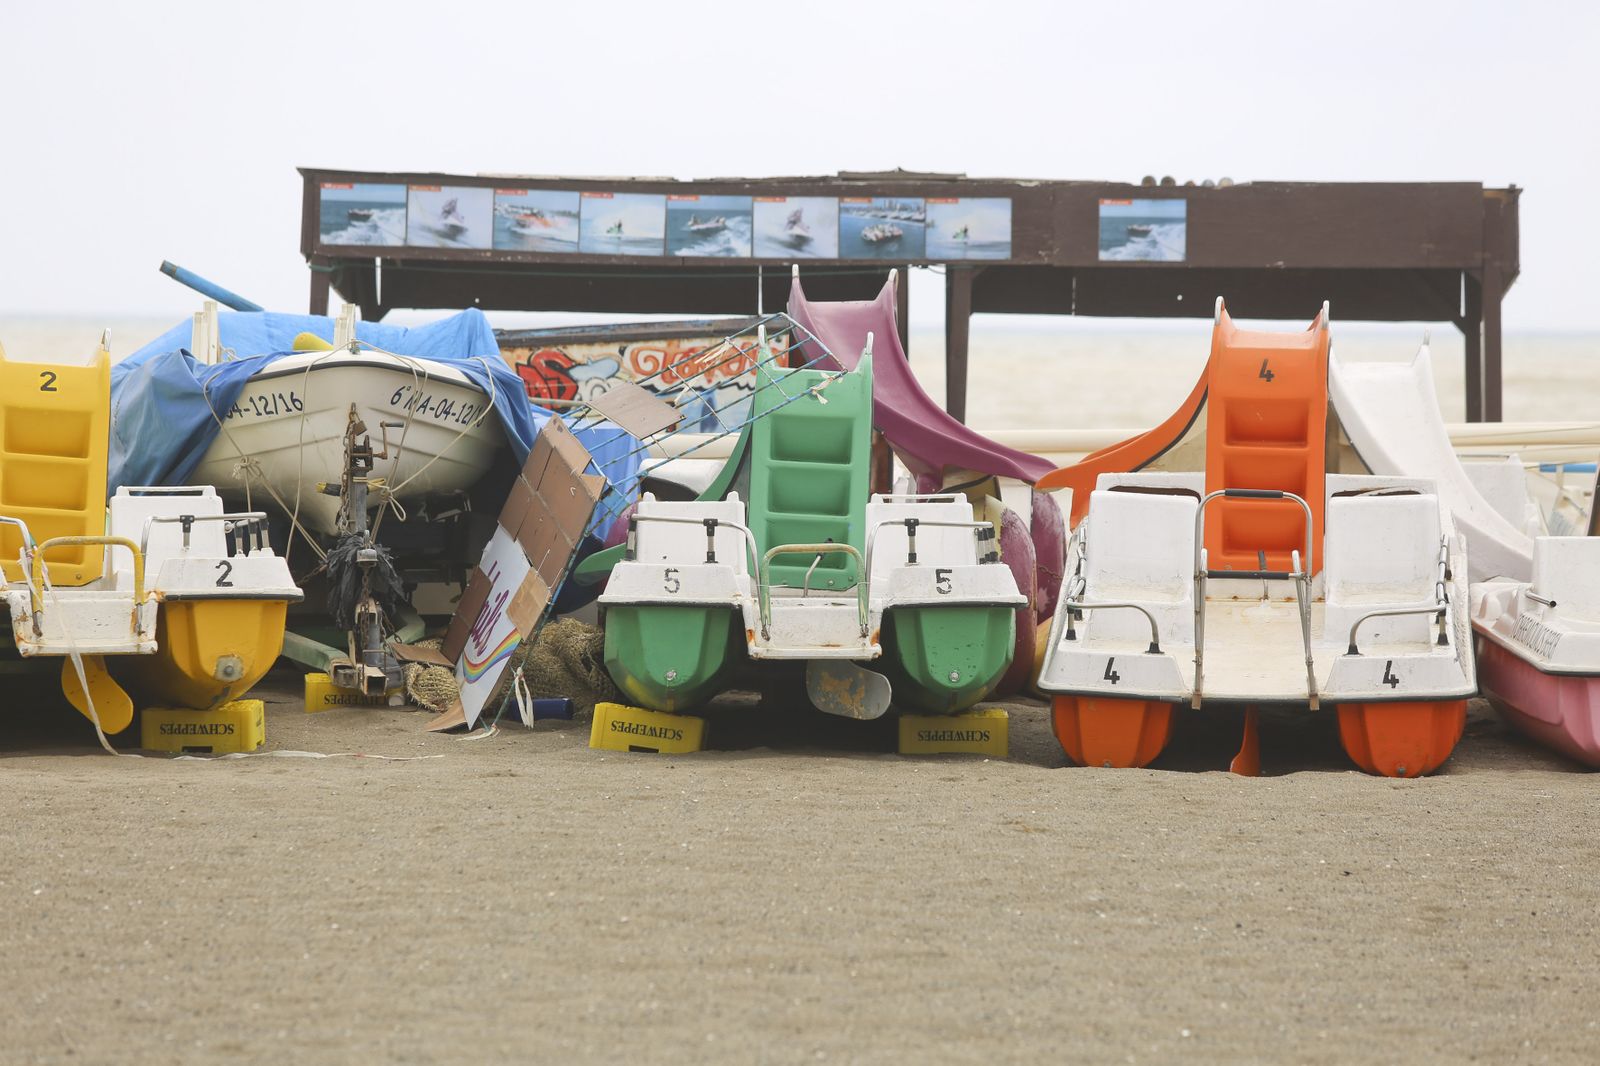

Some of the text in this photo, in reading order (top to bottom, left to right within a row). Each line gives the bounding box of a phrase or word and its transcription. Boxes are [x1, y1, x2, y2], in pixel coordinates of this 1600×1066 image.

[39, 371, 57, 392] 2
[1259, 359, 1275, 382] 4
[214, 560, 233, 587] 2
[664, 568, 681, 593] 5
[935, 568, 952, 595] 5
[1103, 656, 1119, 684] 4
[1383, 661, 1399, 689] 4
[159, 723, 235, 735] SCHWEPPES
[611, 720, 684, 741] SCHWEPPES
[917, 730, 990, 742] SCHWEPPES
